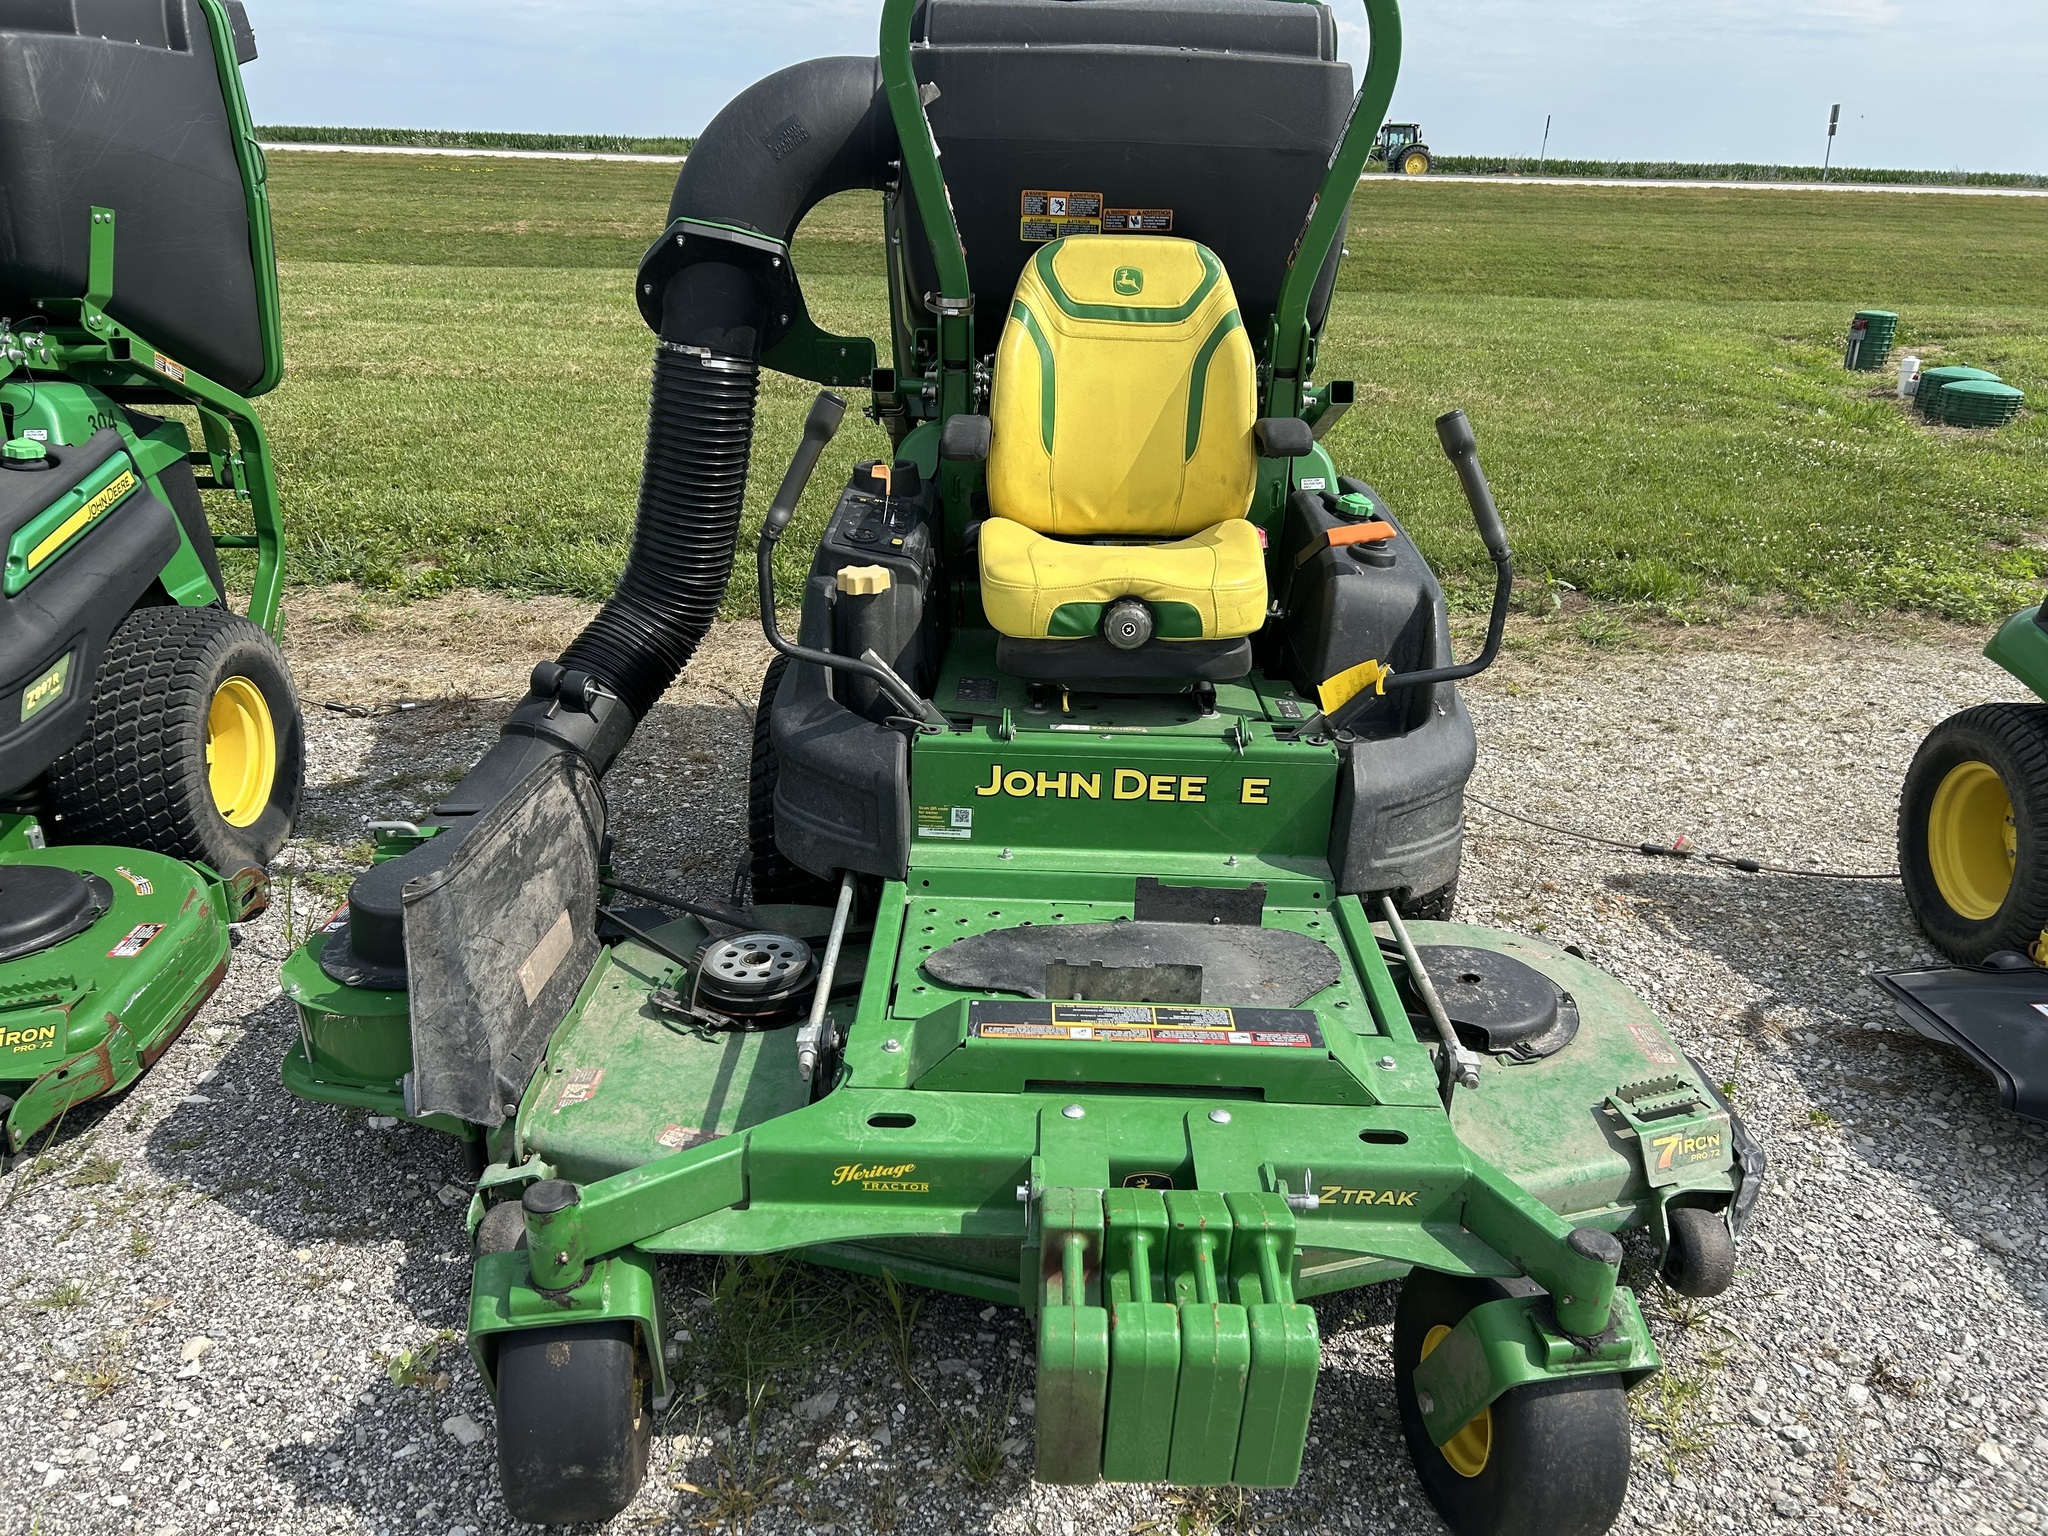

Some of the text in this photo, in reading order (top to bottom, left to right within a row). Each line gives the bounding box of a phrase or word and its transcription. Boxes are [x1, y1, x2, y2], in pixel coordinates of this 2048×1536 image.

[87, 408, 118, 437] 304
[87, 475, 131, 521] JOHN DEERE
[975, 763, 1102, 800] JOHN
[13, 1043, 36, 1053] PRO
[1691, 1149, 1721, 1162] PRO 72
[831, 1163, 917, 1186] Heritage
[862, 1181, 929, 1192] TRACTOR
[1319, 1186, 1419, 1206] ZTRAK
